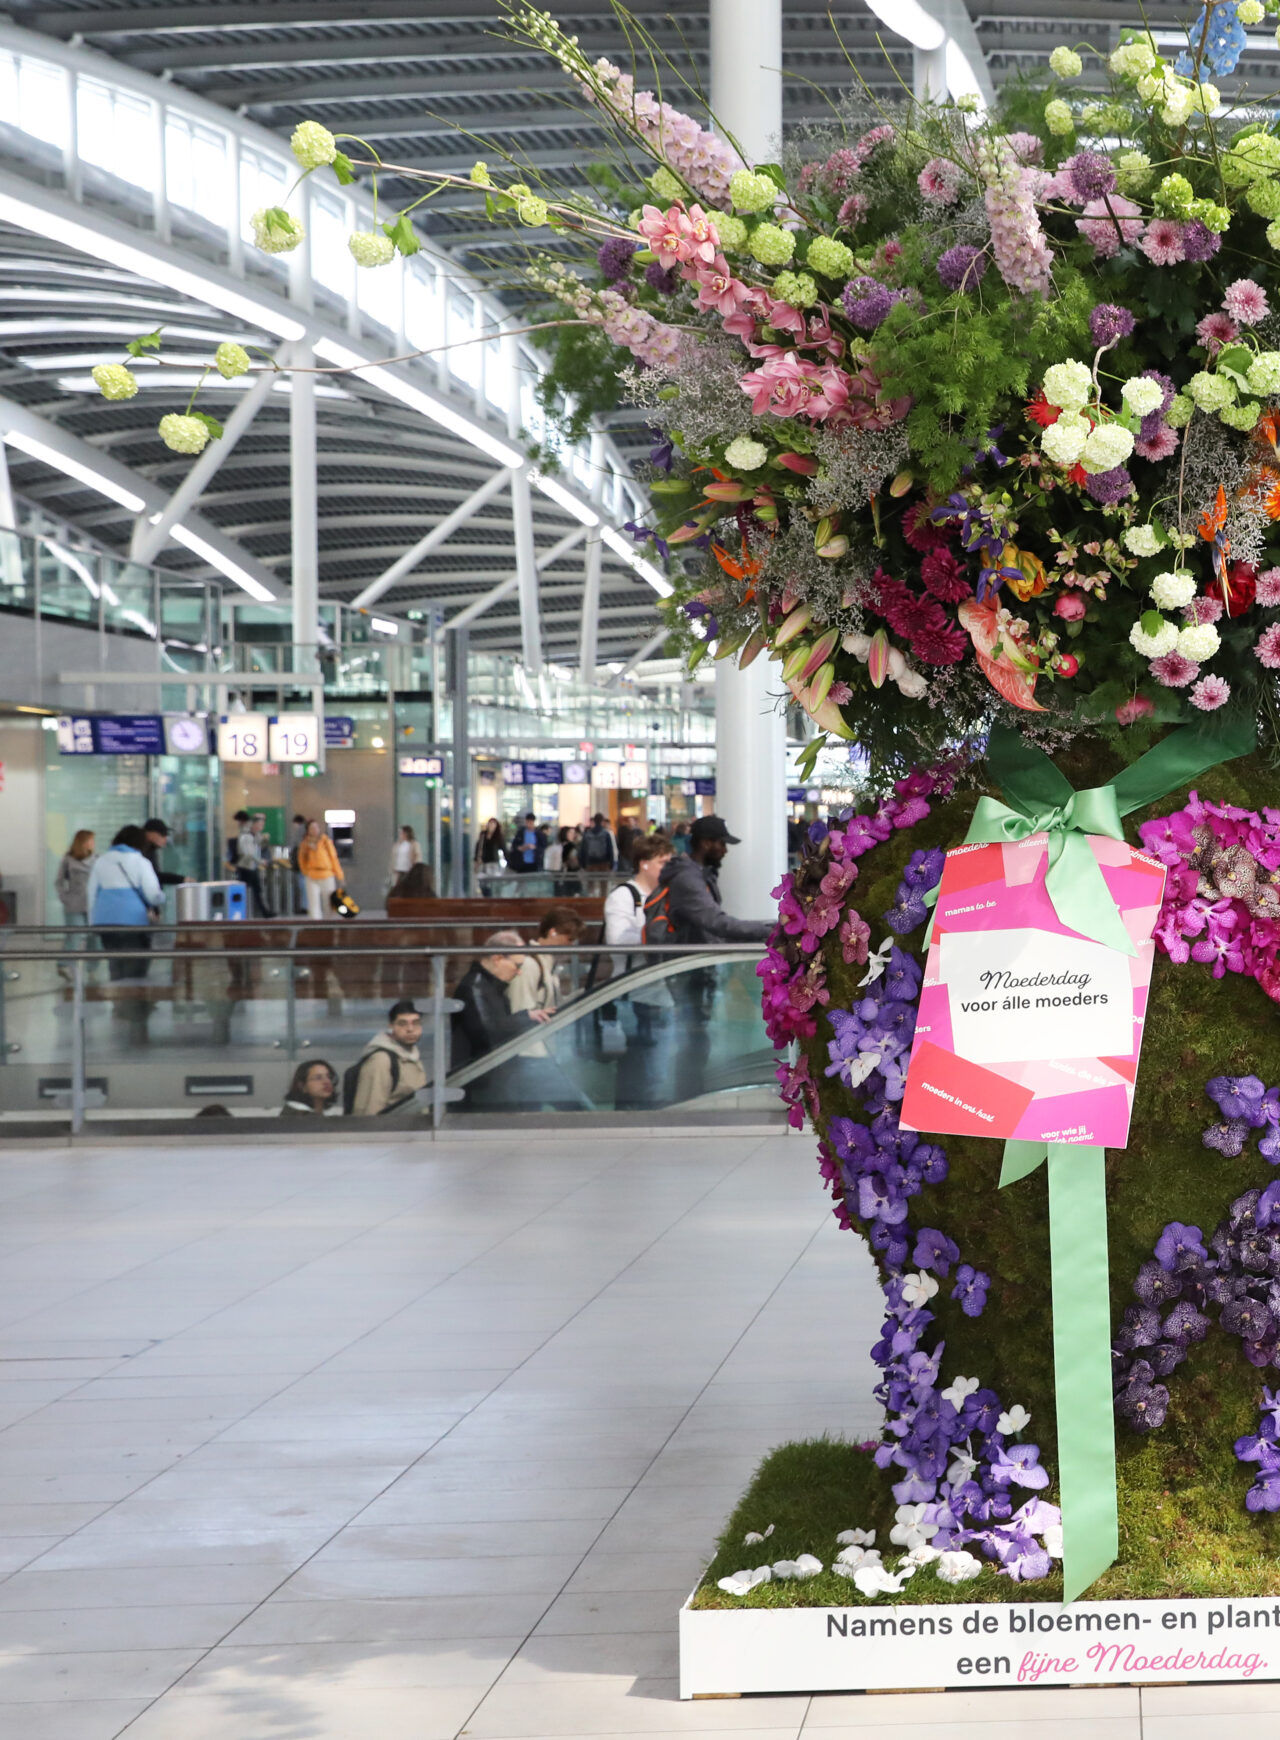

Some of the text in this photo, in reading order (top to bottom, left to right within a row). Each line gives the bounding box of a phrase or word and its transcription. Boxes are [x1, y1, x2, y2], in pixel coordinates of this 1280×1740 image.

[229, 733, 258, 756] 18
[281, 733, 308, 756] 19
[945, 900, 997, 917] mamas to be
[980, 970, 1091, 990] Moederdag
[961, 992, 1109, 1013] voor álle moeders
[921, 1082, 955, 1103] moeders
[954, 1096, 963, 1107] in
[1041, 1125, 1087, 1139] voor wie jij
[826, 1613, 953, 1637] Namens
[962, 1610, 999, 1634] de
[1009, 1609, 1151, 1633] bloemen-
[1161, 1611, 1197, 1630] en
[956, 1642, 1269, 1682] een fijne Moederdag.
